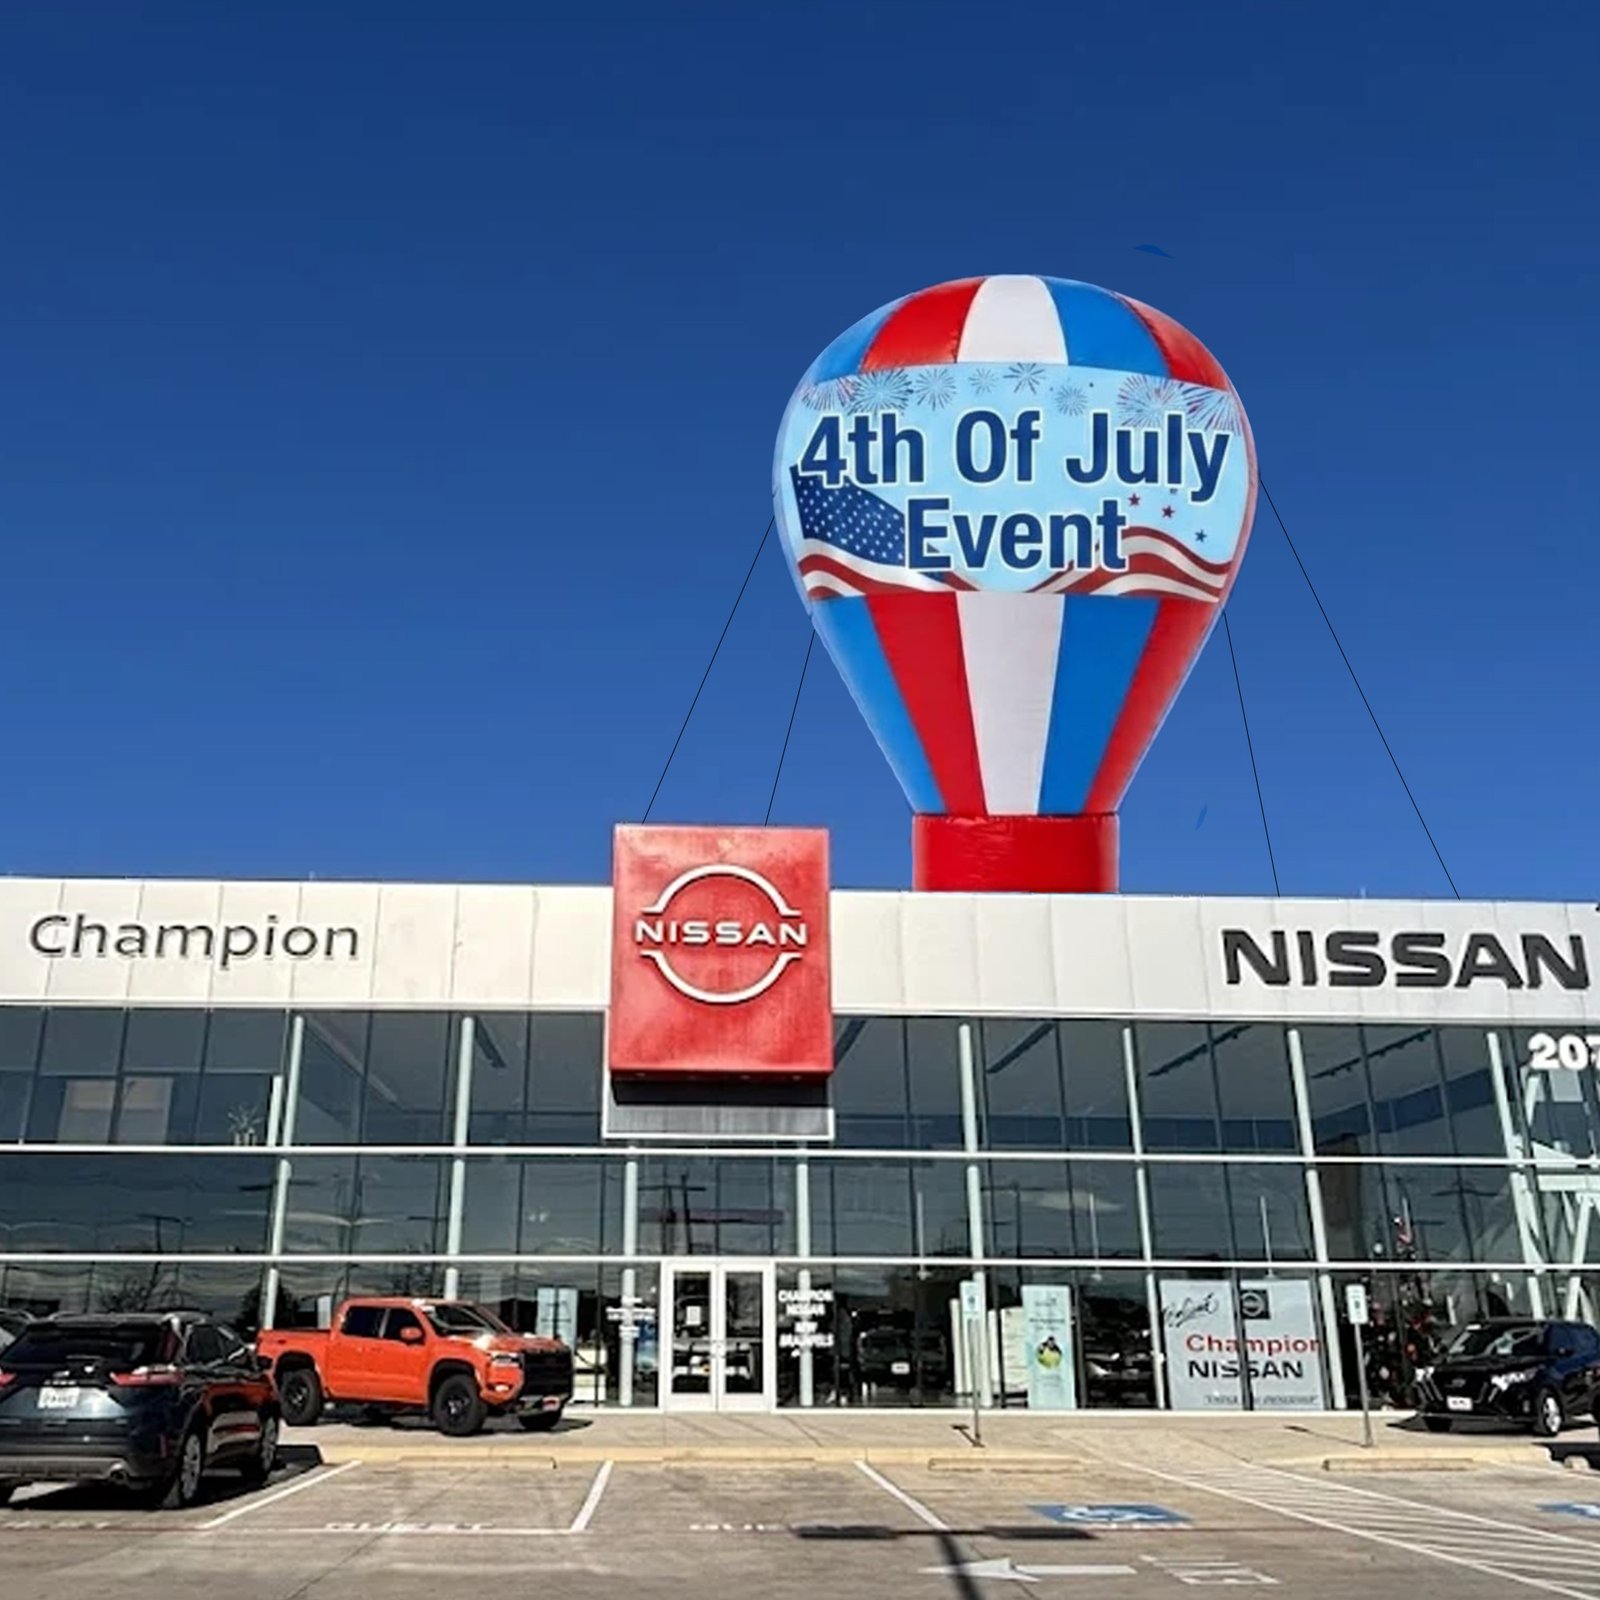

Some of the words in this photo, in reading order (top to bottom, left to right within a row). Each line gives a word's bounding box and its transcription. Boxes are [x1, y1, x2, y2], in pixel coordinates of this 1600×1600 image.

[800, 412, 925, 485] 4th
[955, 410, 1041, 483] Of
[1065, 411, 1231, 501] July
[906, 497, 1127, 569] Event
[29, 913, 359, 969] Champion
[635, 919, 808, 946] NISSAN
[1221, 929, 1591, 990] NISSAN
[1188, 1360, 1304, 1379] NISSAN
